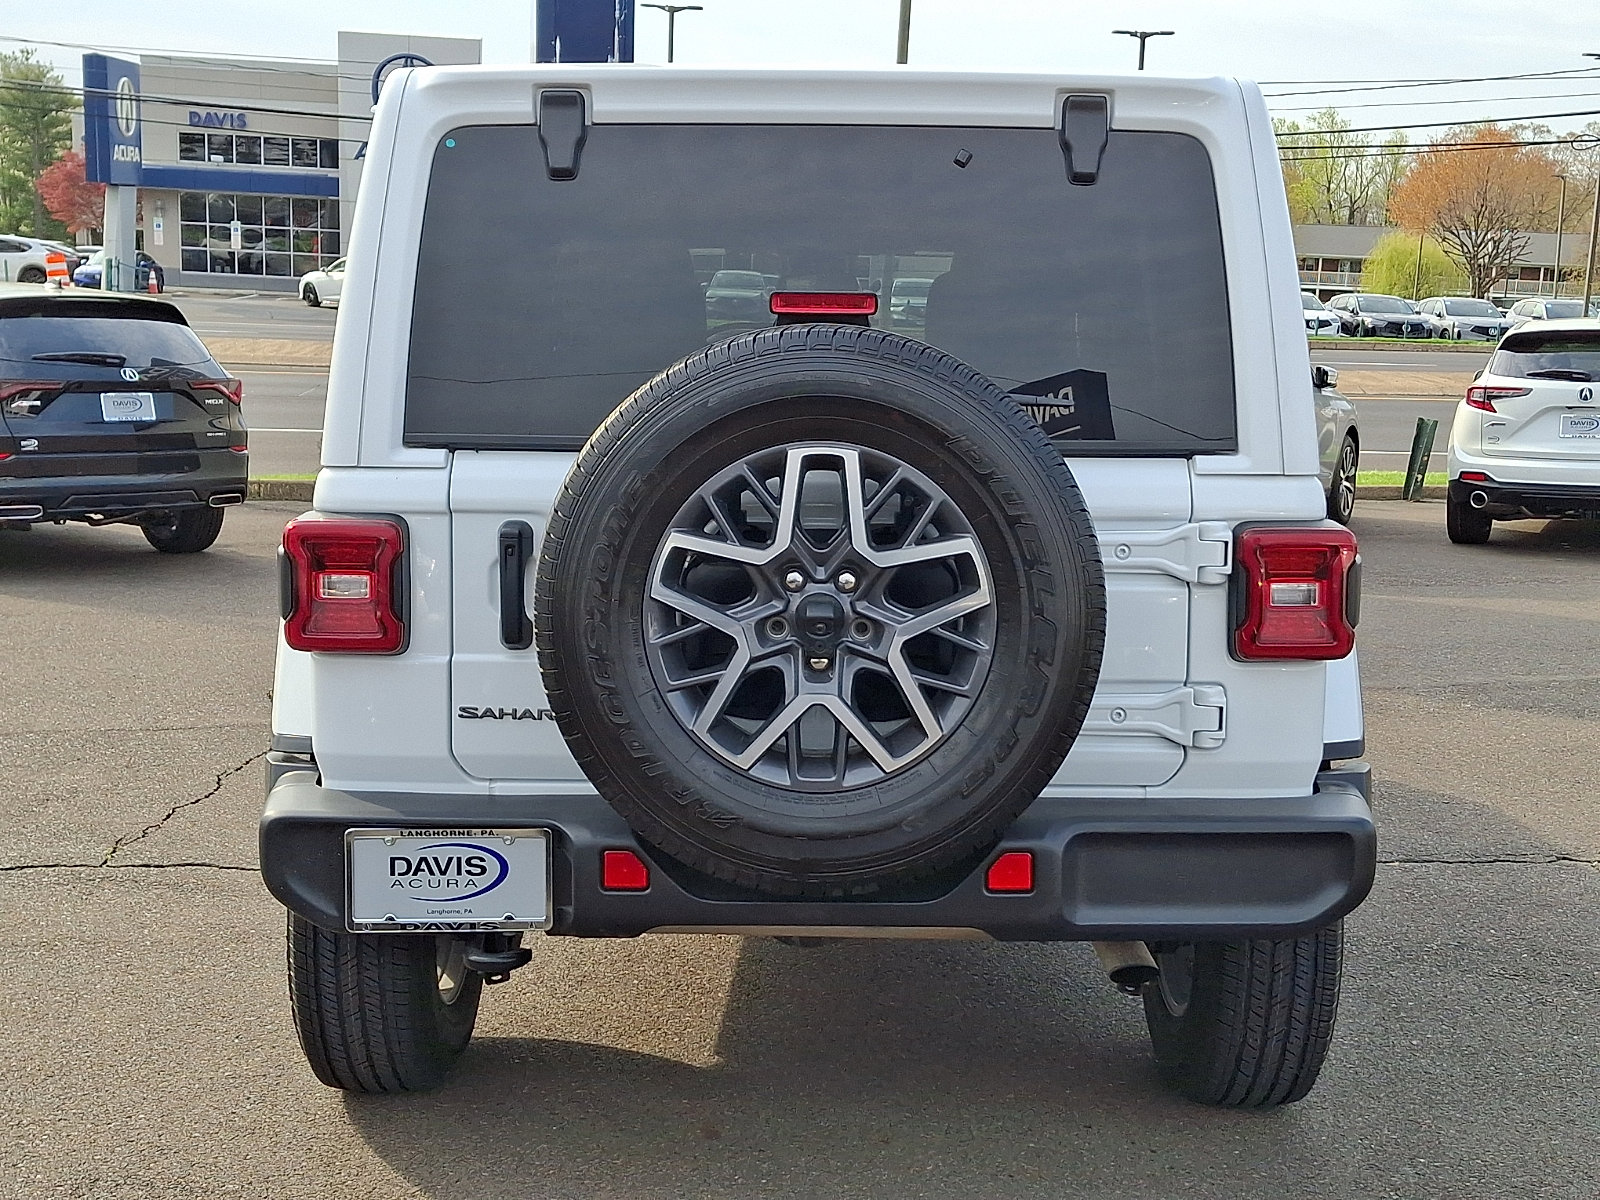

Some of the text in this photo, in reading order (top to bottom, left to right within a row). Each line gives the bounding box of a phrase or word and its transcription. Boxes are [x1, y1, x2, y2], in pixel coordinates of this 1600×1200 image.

[188, 111, 247, 129] DAVIS
[112, 144, 141, 163] ACURA
[388, 855, 488, 877] DAVIS
[390, 877, 479, 889] ACURA
[426, 908, 463, 916] Langhorne,
[398, 921, 501, 931] DAVIS
